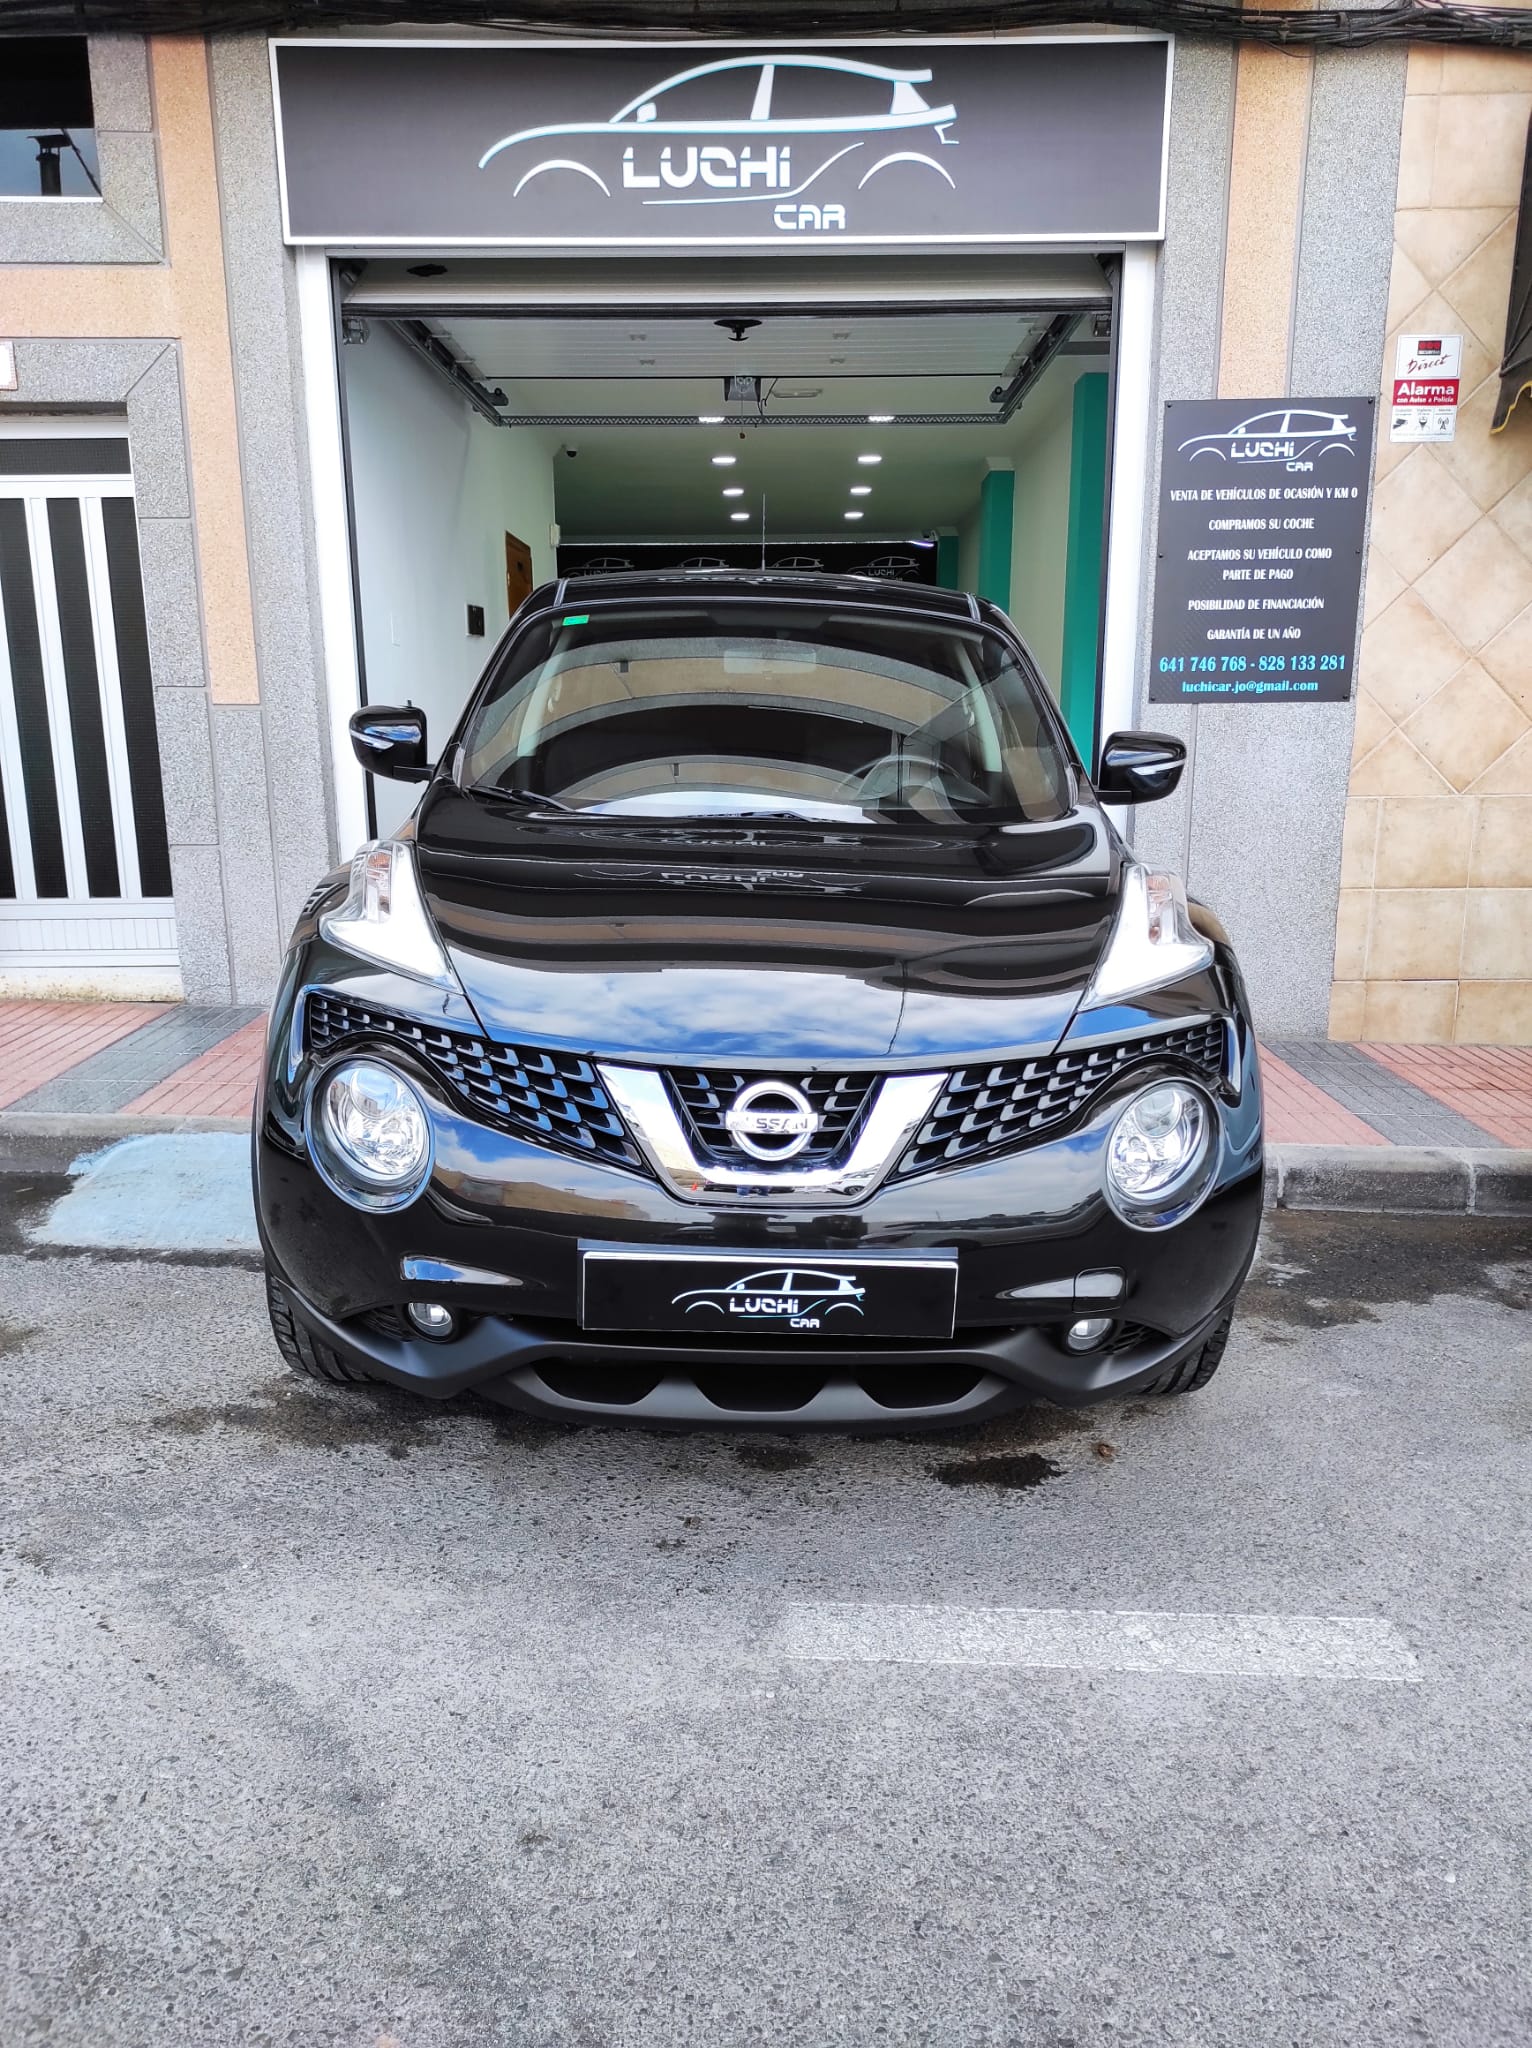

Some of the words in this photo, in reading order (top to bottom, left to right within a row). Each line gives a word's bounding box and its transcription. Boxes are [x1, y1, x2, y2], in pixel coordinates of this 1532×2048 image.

[622, 146, 791, 188] LUCHI
[773, 204, 846, 230] CAR
[1398, 382, 1455, 395] Alarma
[1231, 441, 1294, 458] LUCHI
[1286, 461, 1313, 472] CAR
[1170, 490, 1198, 501] VENTA
[1200, 489, 1214, 501] DE
[1215, 486, 1266, 500] VEHÍCULOS
[1268, 488, 1281, 500] DE
[1283, 485, 1324, 499] OCASIÓN
[1326, 487, 1333, 499] Y
[1334, 487, 1349, 499] KM
[1208, 518, 1266, 531] COMPRAMOS
[1268, 518, 1282, 530] SU
[1283, 517, 1315, 530] COCHE
[1187, 549, 1241, 561] ACEPTAMOS
[1243, 548, 1256, 560] SU
[1257, 546, 1303, 560] VEHÍCULO
[1304, 547, 1333, 559] COMO
[1222, 569, 1252, 581] PARTE
[1253, 569, 1267, 580] DE
[1268, 568, 1294, 580] PAGO
[1188, 599, 1246, 611] POSIBILIDAD
[1247, 599, 1261, 610] DE
[1262, 595, 1325, 610] FINANCIACIÓN
[1206, 626, 1251, 640] GARANTÍA
[1252, 628, 1266, 639] DE
[1267, 628, 1281, 639] UN
[1282, 625, 1302, 639] AÑO
[1159, 657, 1185, 672] 641
[1190, 656, 1217, 672] 746
[1221, 656, 1247, 671] 768
[1258, 655, 1286, 671] 828
[1291, 655, 1316, 670] 133
[1319, 654, 1345, 670] 281
[1182, 680, 1318, 694] luchicar.jo@gmail.com
[730, 1297, 799, 1314] LUCHI
[790, 1318, 820, 1329] CAR
